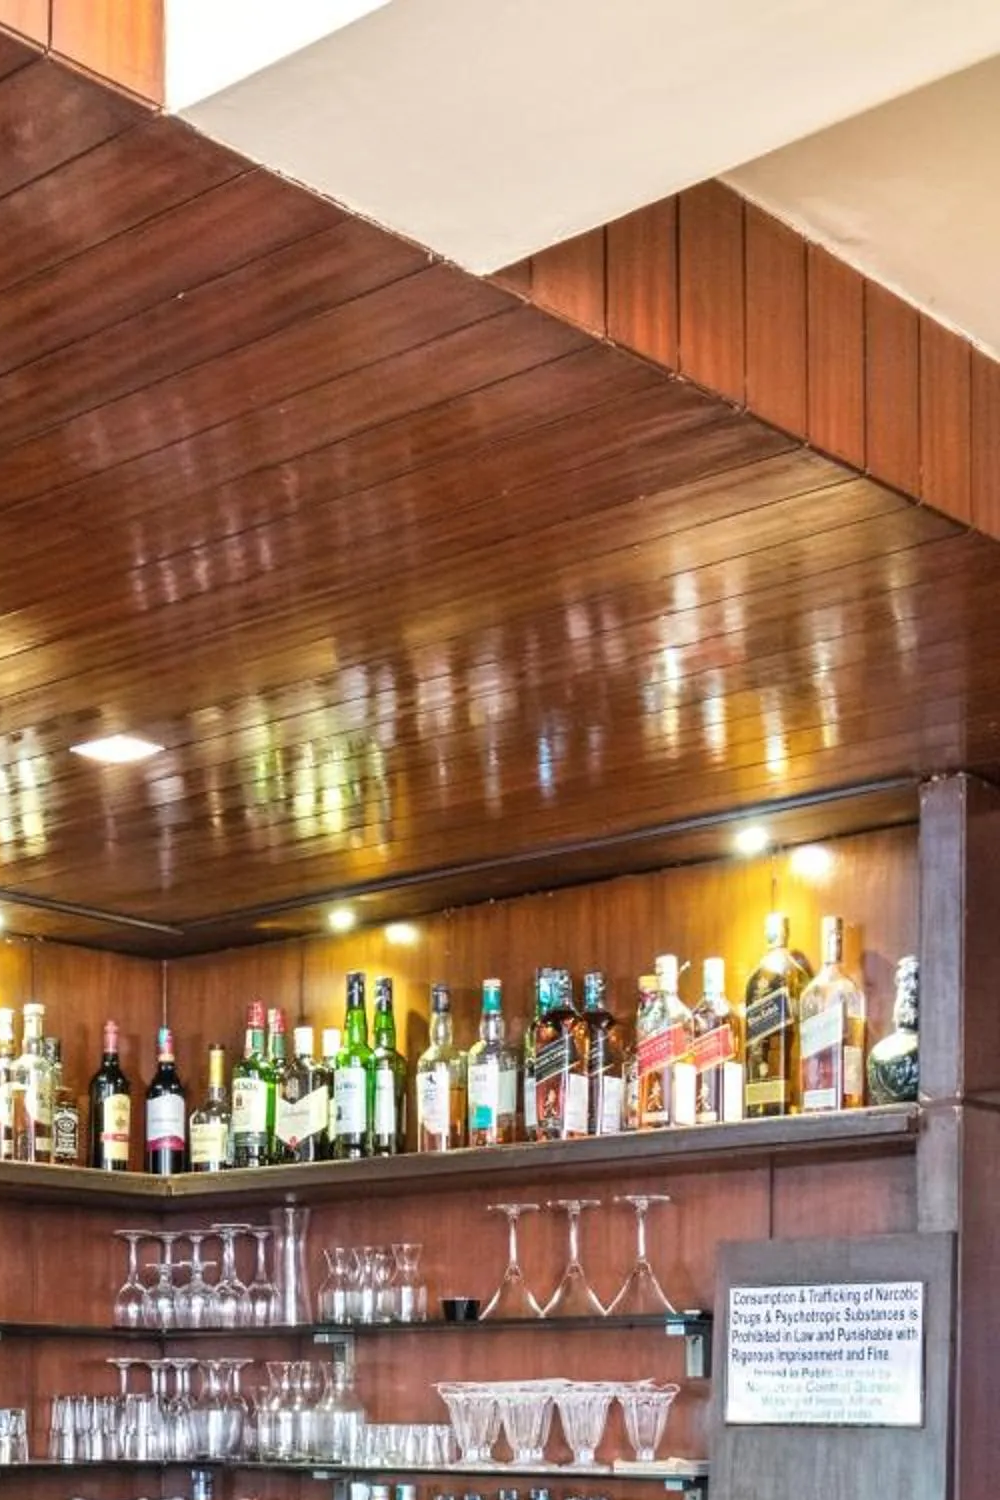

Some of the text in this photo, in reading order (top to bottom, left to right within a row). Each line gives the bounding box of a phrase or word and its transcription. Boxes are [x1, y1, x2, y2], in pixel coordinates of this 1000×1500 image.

[733, 1291, 797, 1307] Consumption
[808, 1288, 861, 1306] Trafficking
[863, 1287, 873, 1301] of
[875, 1285, 919, 1301] Narcotic
[732, 1311, 761, 1327] Drugs
[775, 1309, 841, 1326] Psychotropic
[844, 1307, 905, 1322] Substances
[909, 1307, 919, 1321] is
[732, 1327, 918, 1343] Prohibited in Law and Punishable with
[846, 1347, 865, 1361] and
